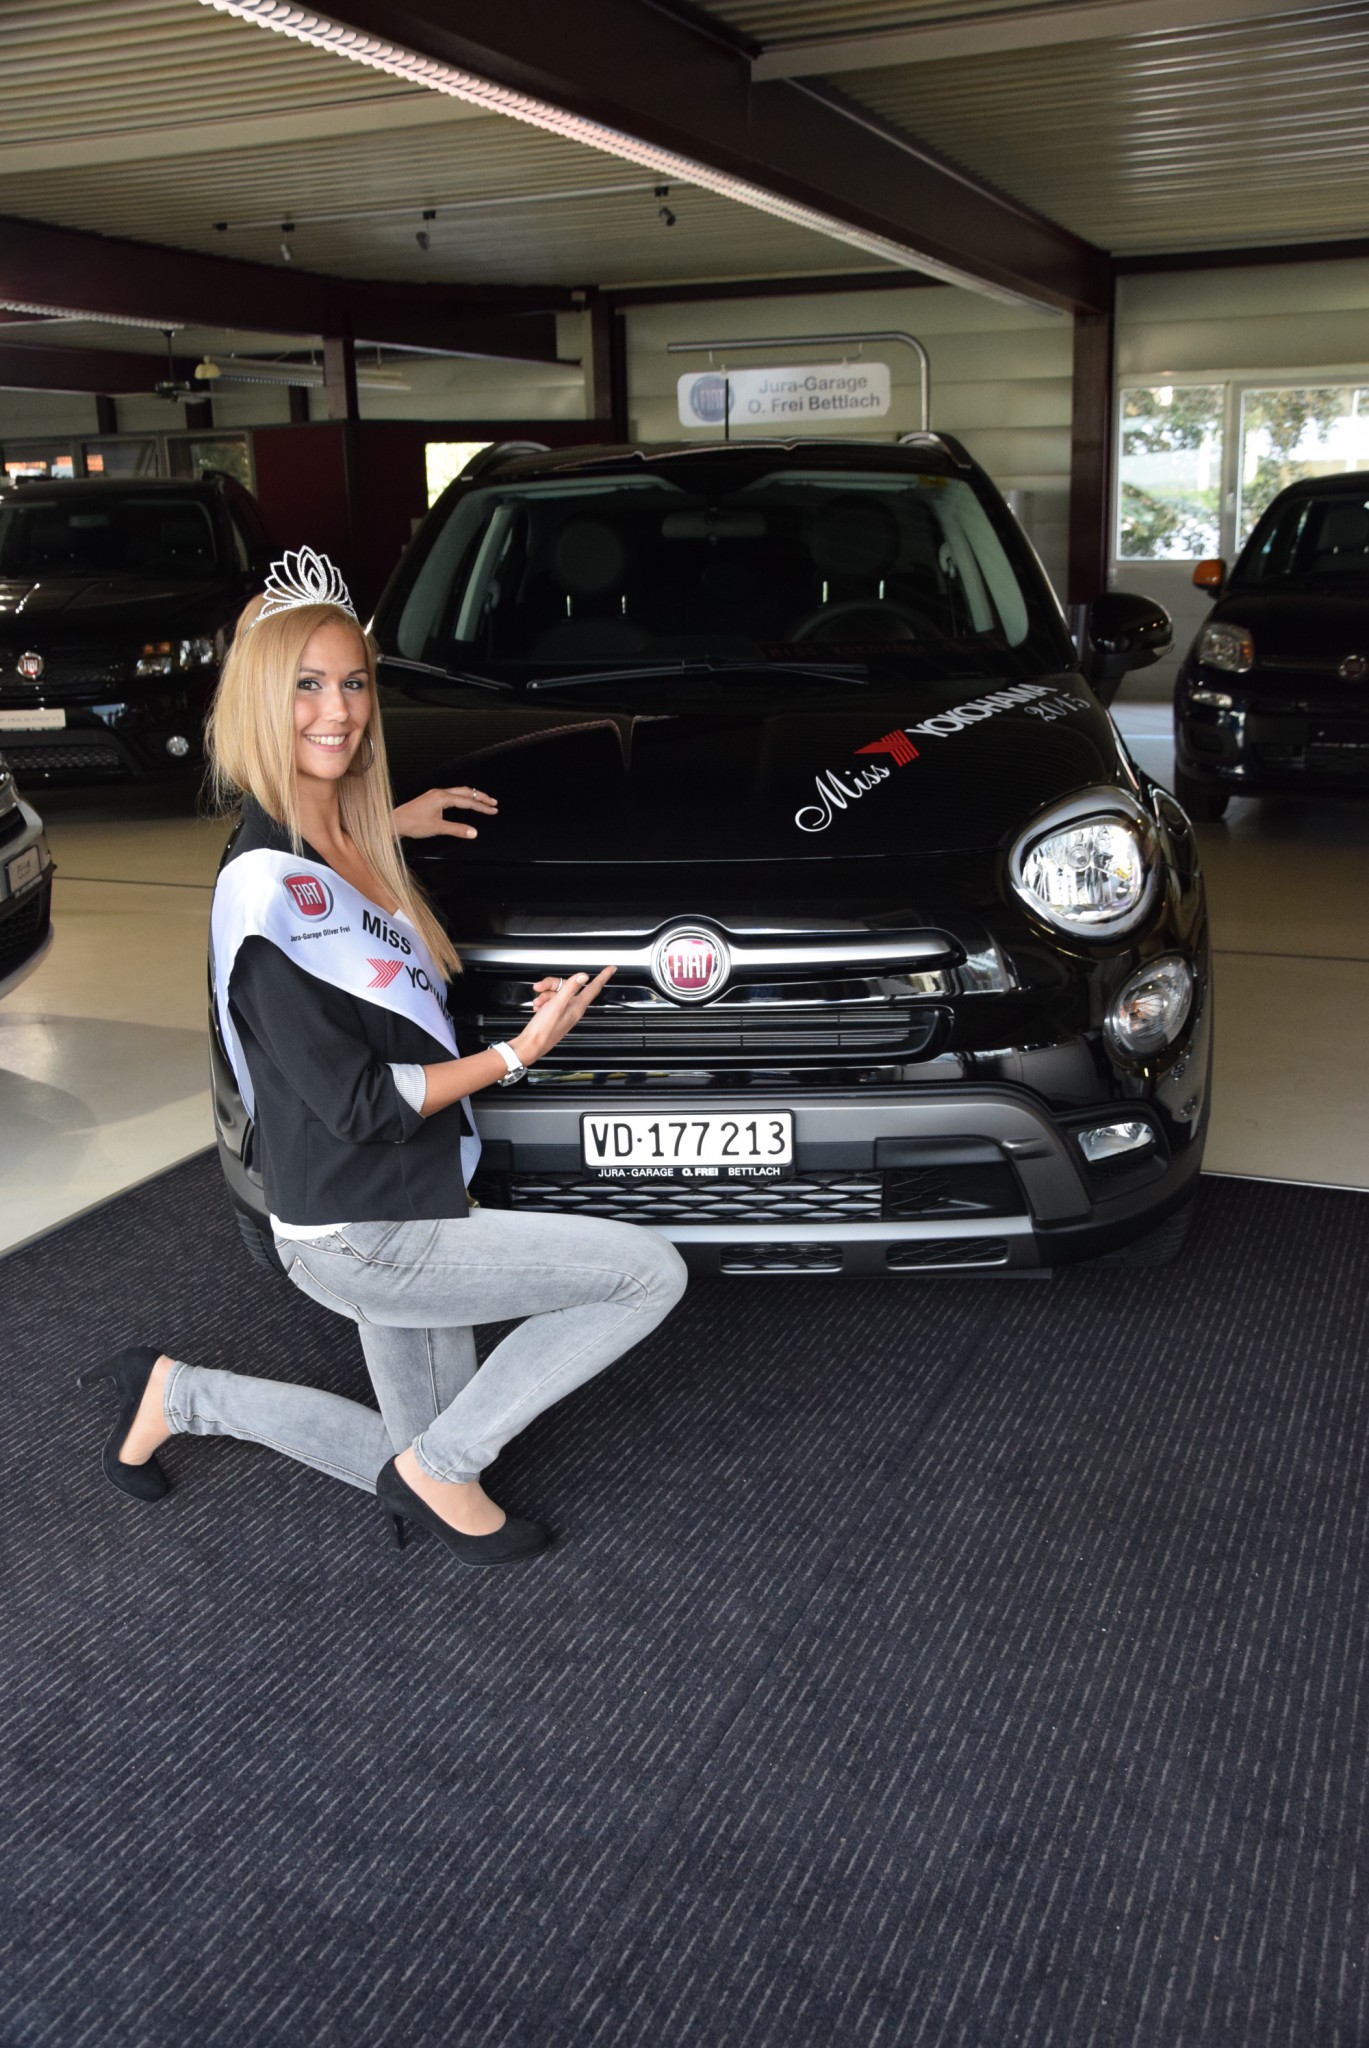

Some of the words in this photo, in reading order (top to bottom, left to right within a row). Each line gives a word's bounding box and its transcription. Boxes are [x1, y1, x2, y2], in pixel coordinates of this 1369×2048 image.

[759, 374, 868, 395] Jura-Garage
[747, 400, 766, 414] O.
[771, 397, 804, 413] Frei
[809, 394, 880, 412] Bettlach
[1023, 692, 1092, 723] 2015
[794, 764, 891, 833] Miss
[904, 682, 1058, 738] YOKOHAMA
[291, 881, 323, 907] FIAT
[290, 932, 323, 943] Jura-Garage
[322, 928, 340, 937] Oliver
[339, 925, 351, 935] Frei
[672, 949, 710, 979] FIAT
[694, 1167, 719, 1177] FREI
[728, 1166, 781, 1177] BETTLACH
